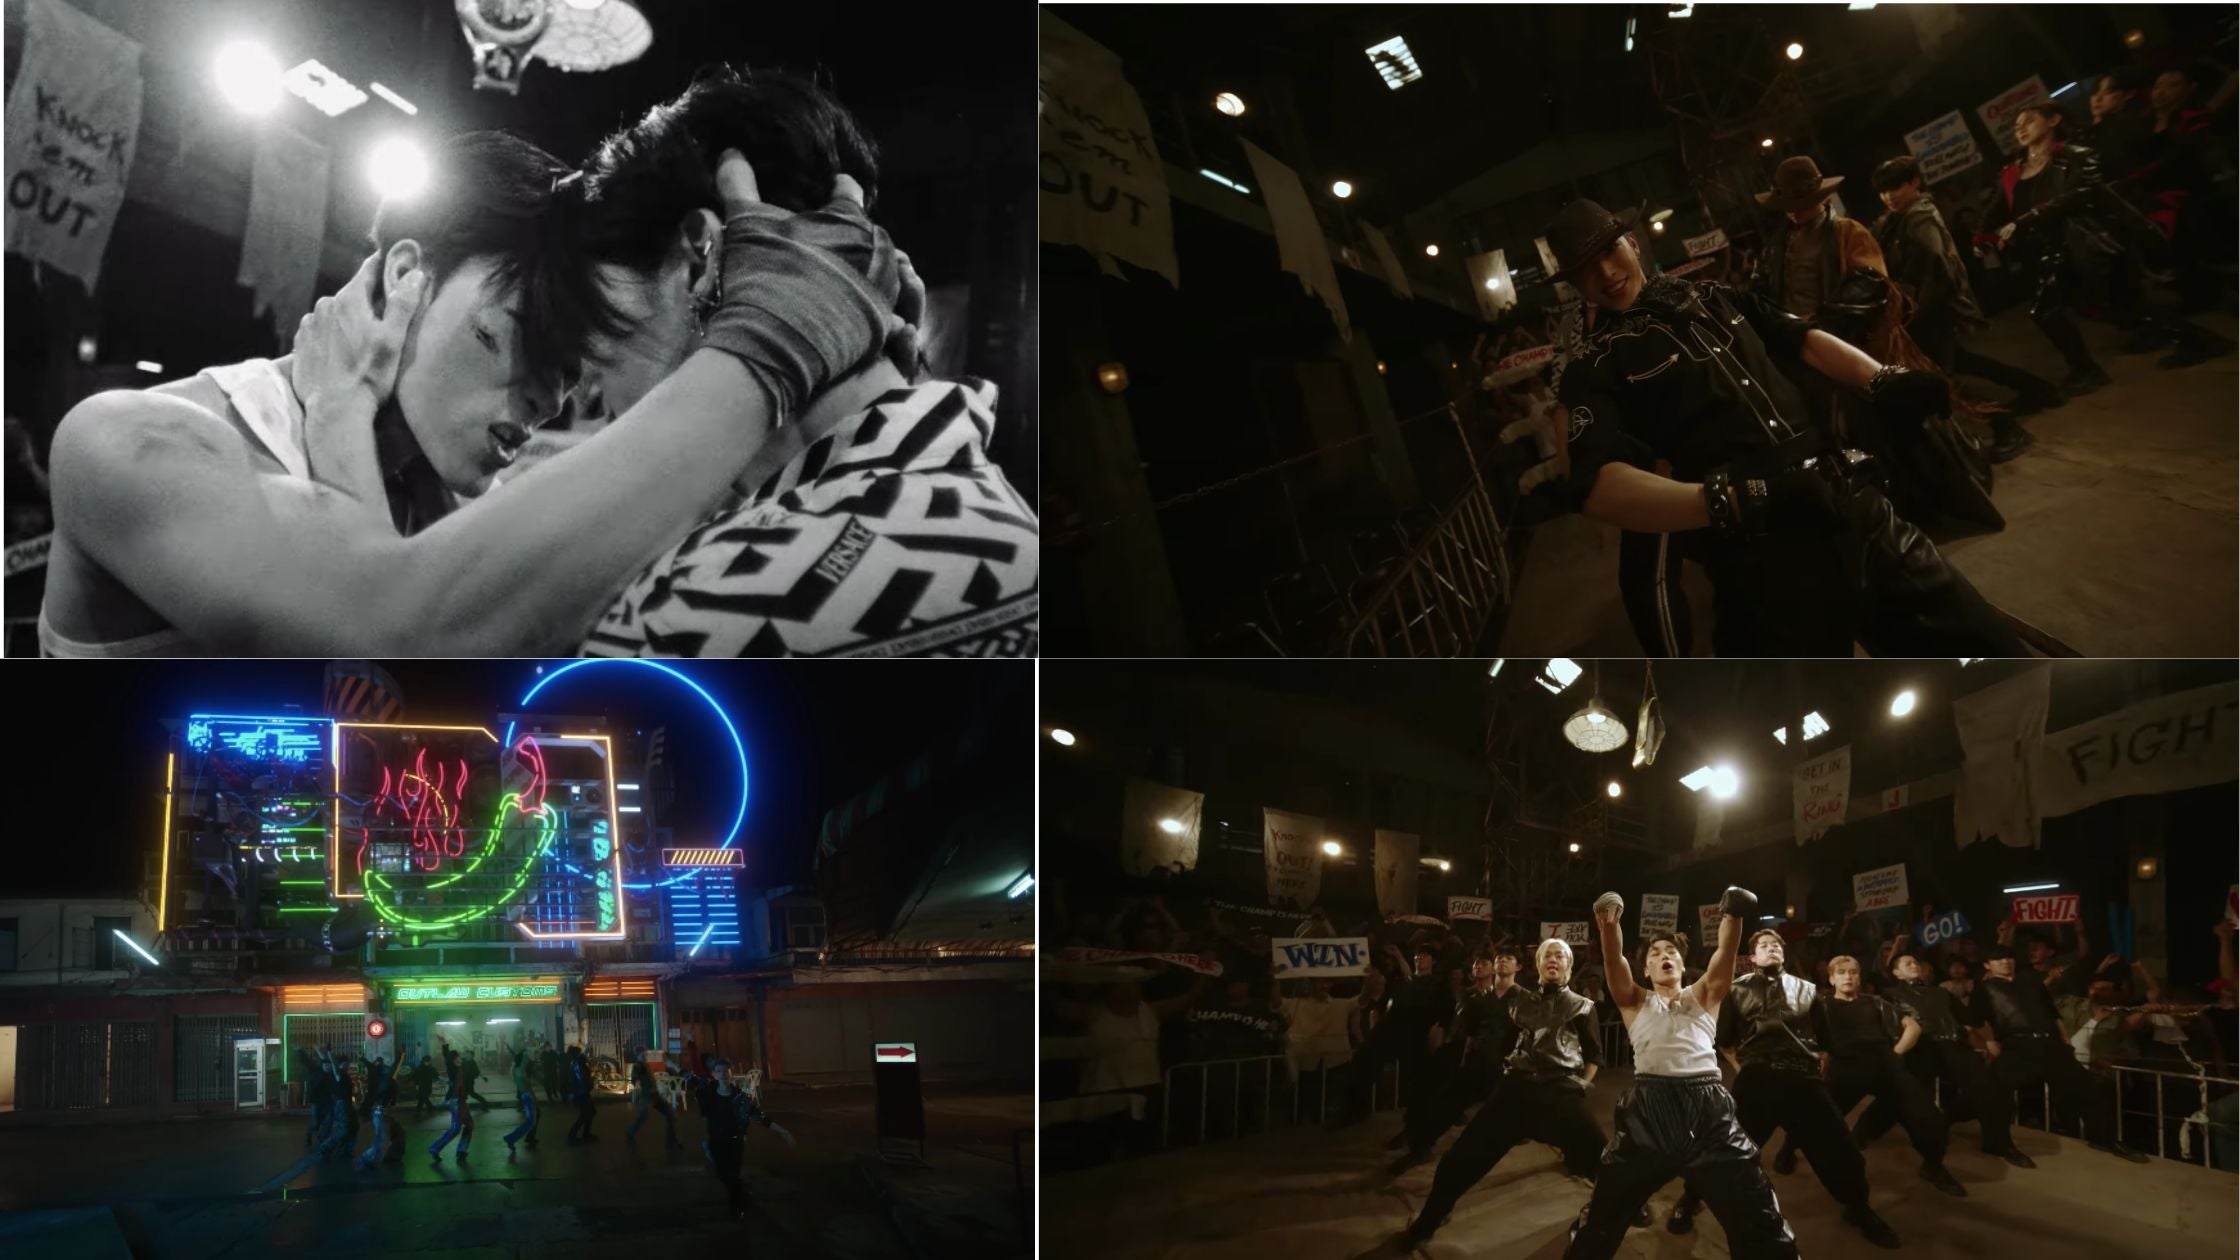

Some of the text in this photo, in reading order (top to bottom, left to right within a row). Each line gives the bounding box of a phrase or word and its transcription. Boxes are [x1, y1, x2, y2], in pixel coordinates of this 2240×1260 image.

[9, 170, 97, 238] OUT
[815, 522, 875, 584] VERSACE
[1451, 900, 1488, 913] FIGHT
[1923, 912, 1963, 945] GO!
[397, 985, 558, 1000] OUTLAW CUSTOMS
